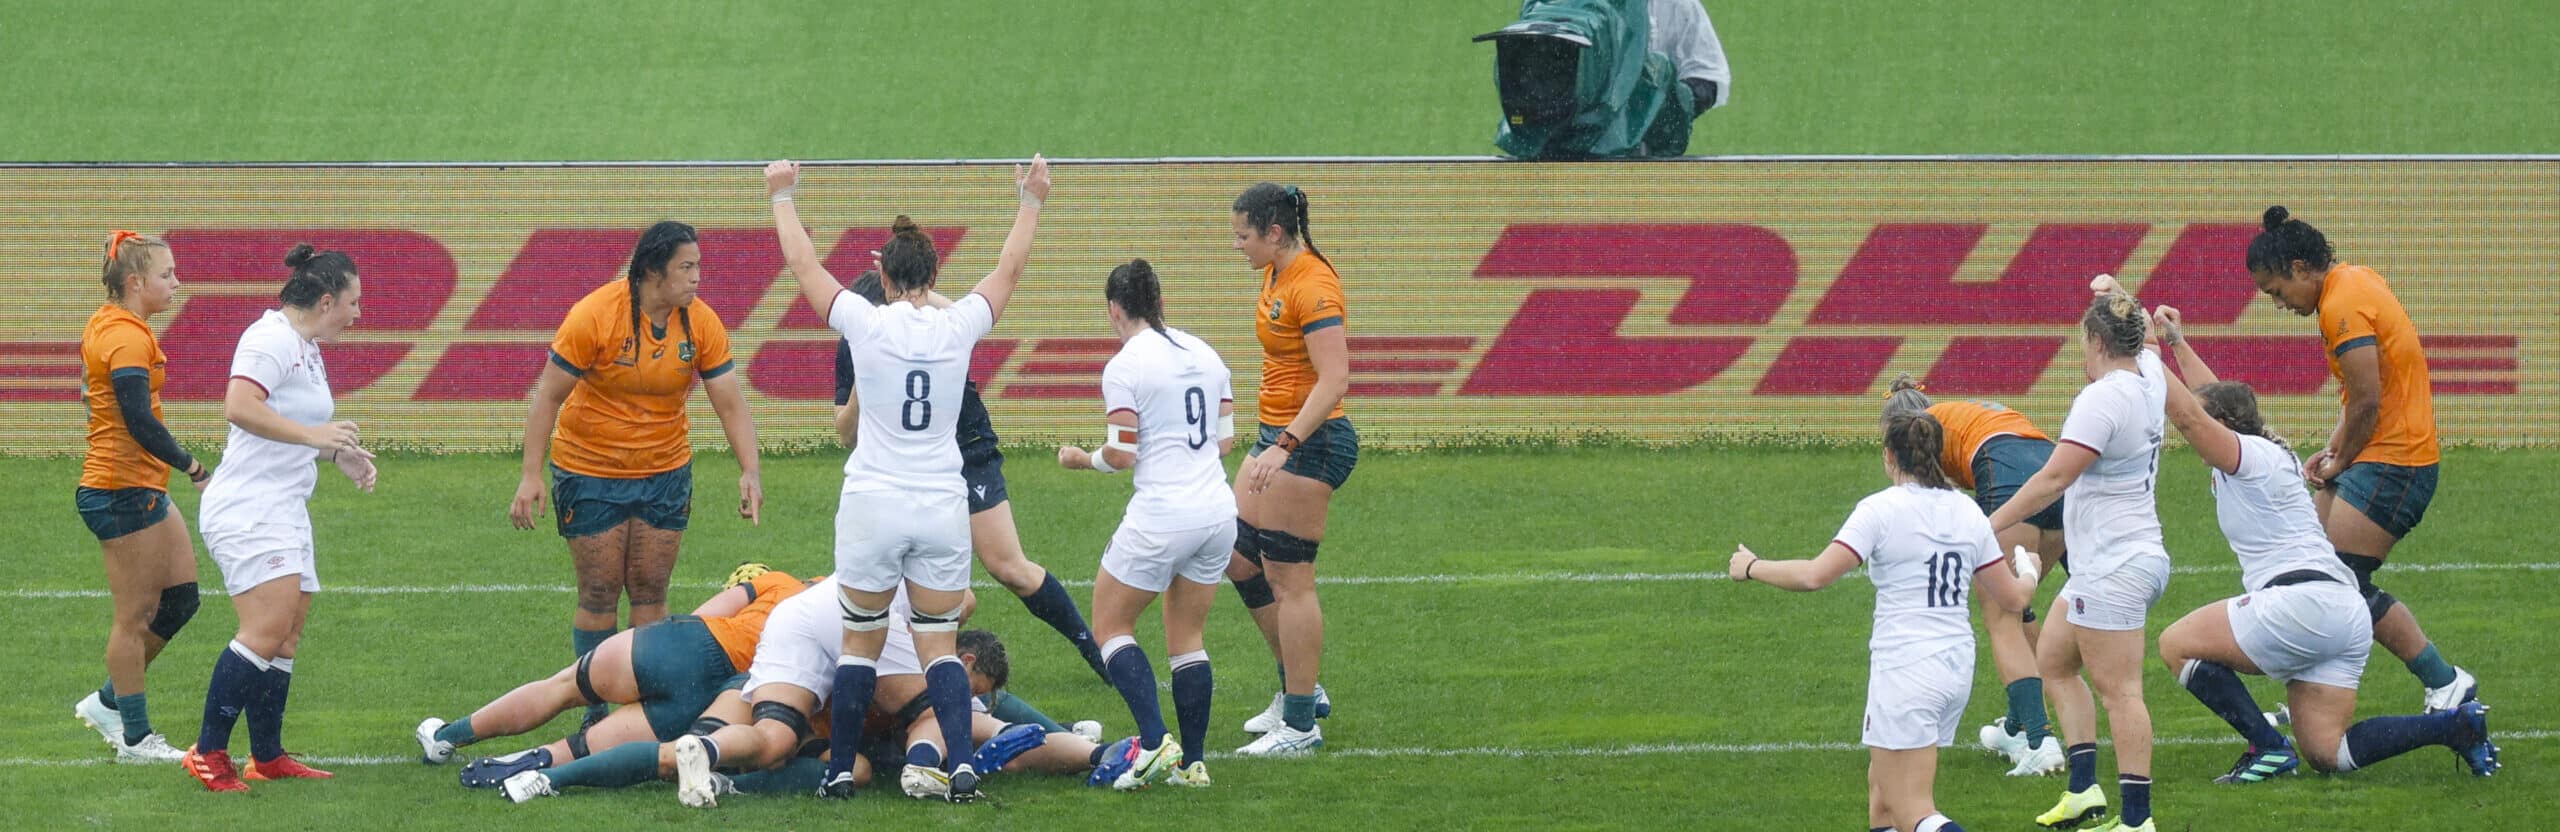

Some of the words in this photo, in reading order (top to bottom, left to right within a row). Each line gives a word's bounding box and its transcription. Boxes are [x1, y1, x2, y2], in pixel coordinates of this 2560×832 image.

[1456, 223, 2334, 396] DHL
[902, 369, 931, 431] 8
[1185, 387, 1207, 450] 9
[1924, 551, 1962, 607] 10
